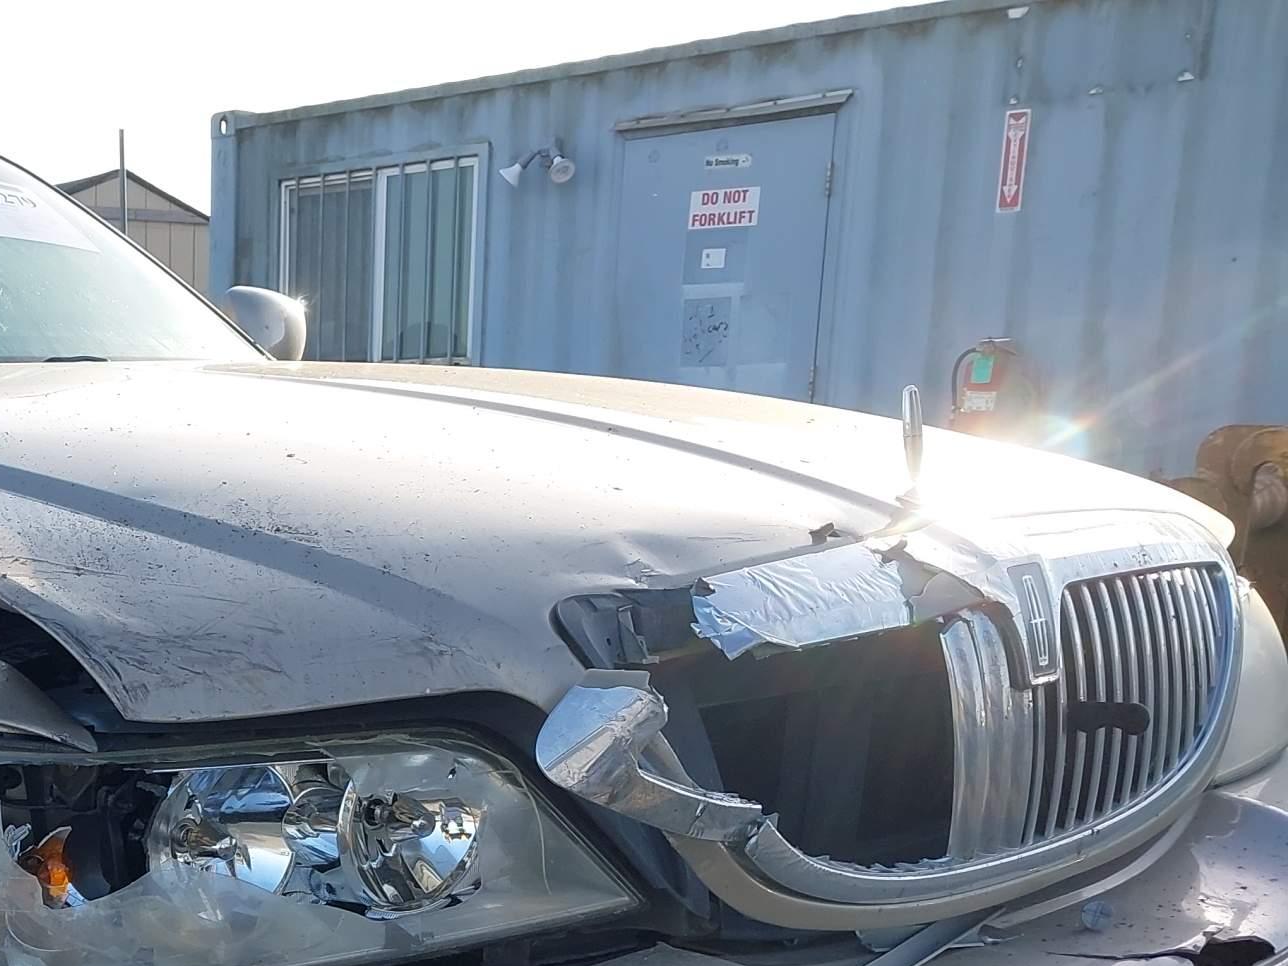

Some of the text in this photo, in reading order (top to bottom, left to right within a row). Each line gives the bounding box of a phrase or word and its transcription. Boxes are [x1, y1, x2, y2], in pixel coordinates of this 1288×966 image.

[701, 189, 749, 206] DO NOT
[691, 210, 755, 227] FORKLIFT
